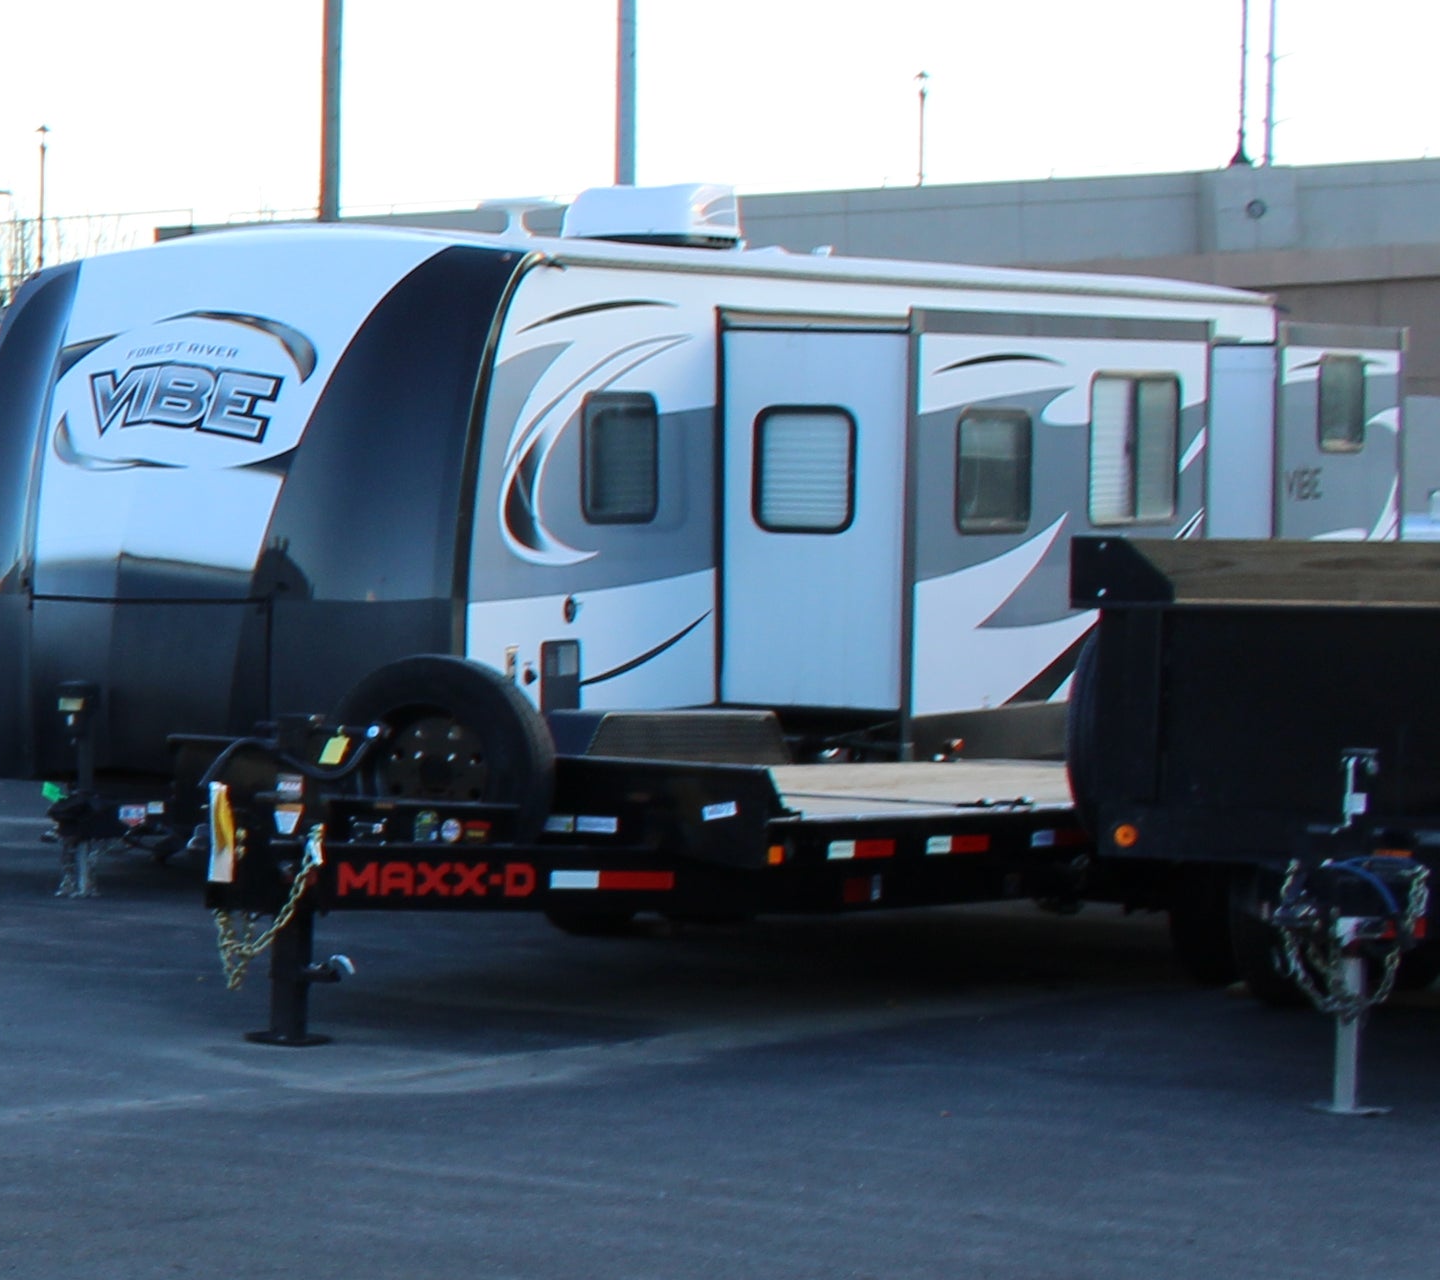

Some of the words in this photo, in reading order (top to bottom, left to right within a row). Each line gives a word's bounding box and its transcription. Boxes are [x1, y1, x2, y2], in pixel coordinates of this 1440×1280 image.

[126, 341, 185, 360] FOREST
[187, 342, 239, 359] RIVER
[89, 360, 284, 444] VIBE
[336, 862, 536, 897] MAXX-D
